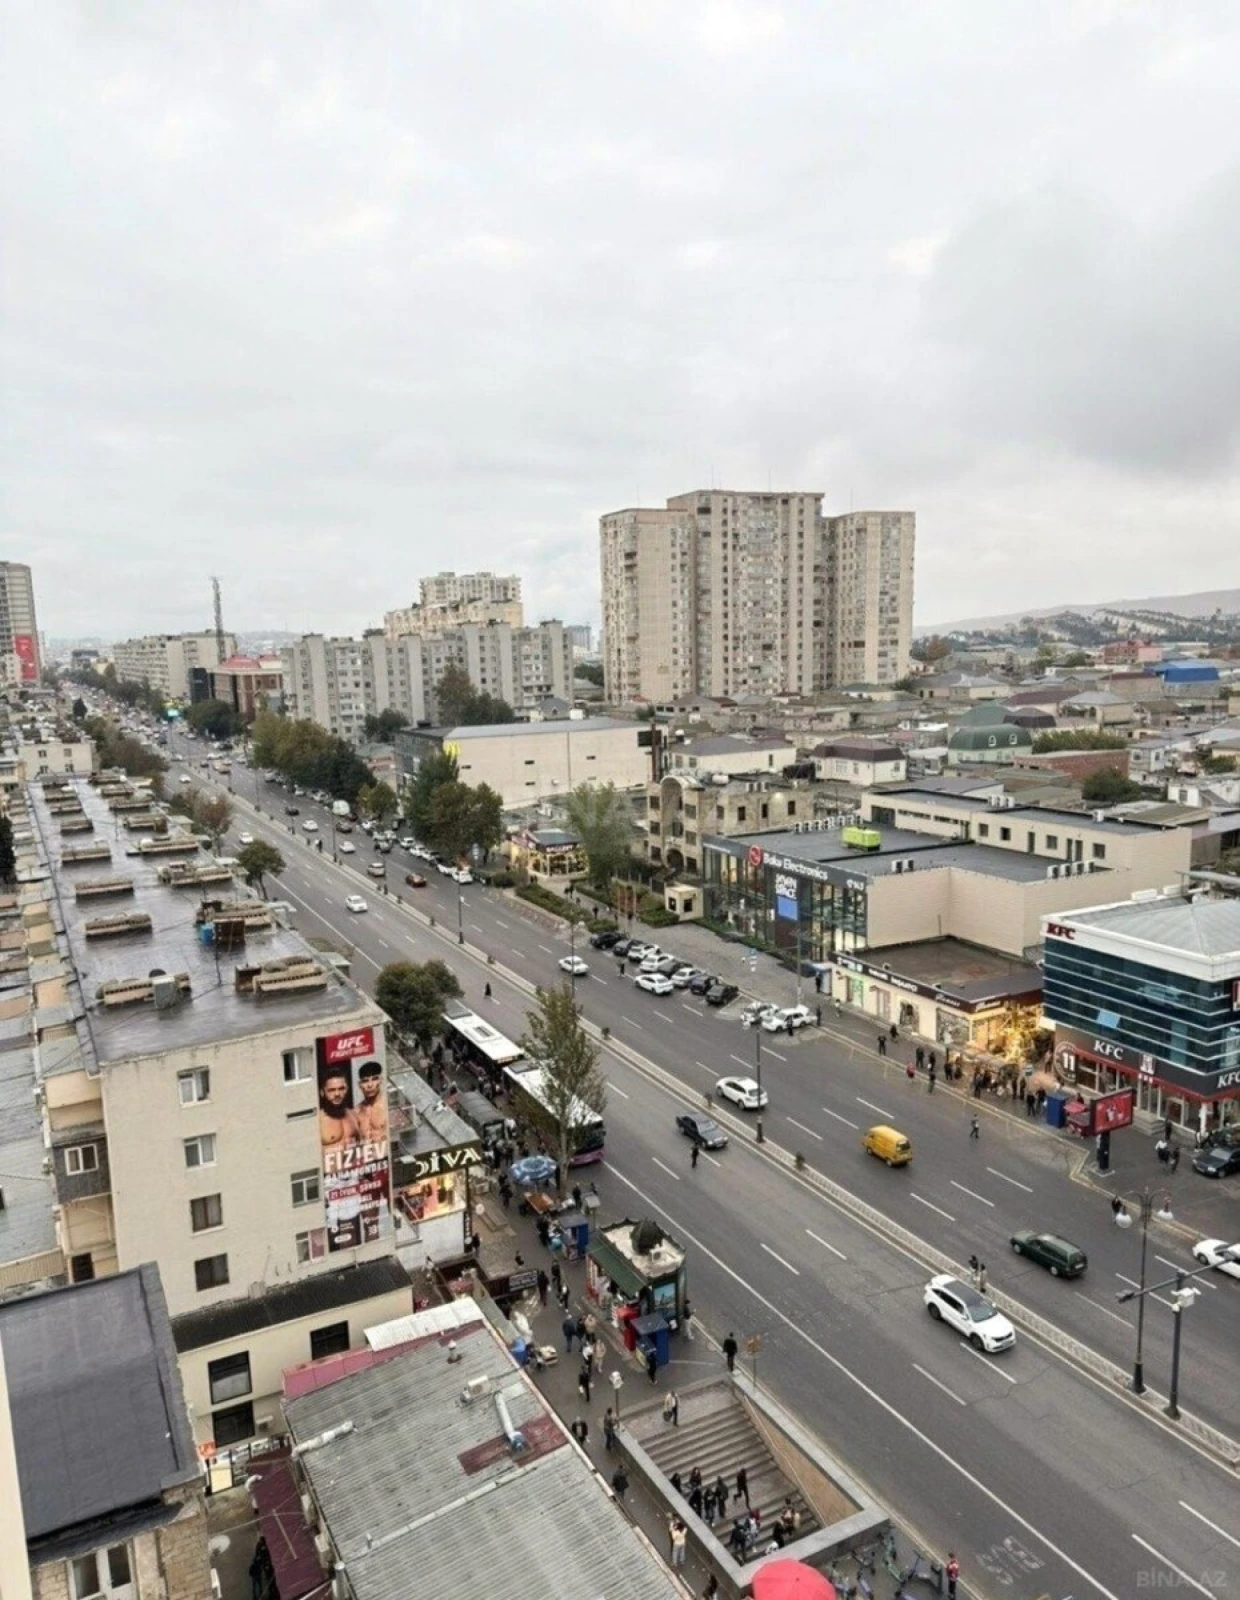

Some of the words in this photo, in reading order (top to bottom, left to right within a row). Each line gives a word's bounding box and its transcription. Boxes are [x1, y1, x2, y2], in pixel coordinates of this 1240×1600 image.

[763, 852, 782, 868] Baku
[783, 858, 828, 881] Electronics
[1046, 922, 1076, 940] KFC
[337, 1035, 366, 1050] UFC
[1093, 1039, 1124, 1061] KFC
[1062, 1051, 1076, 1071] 11
